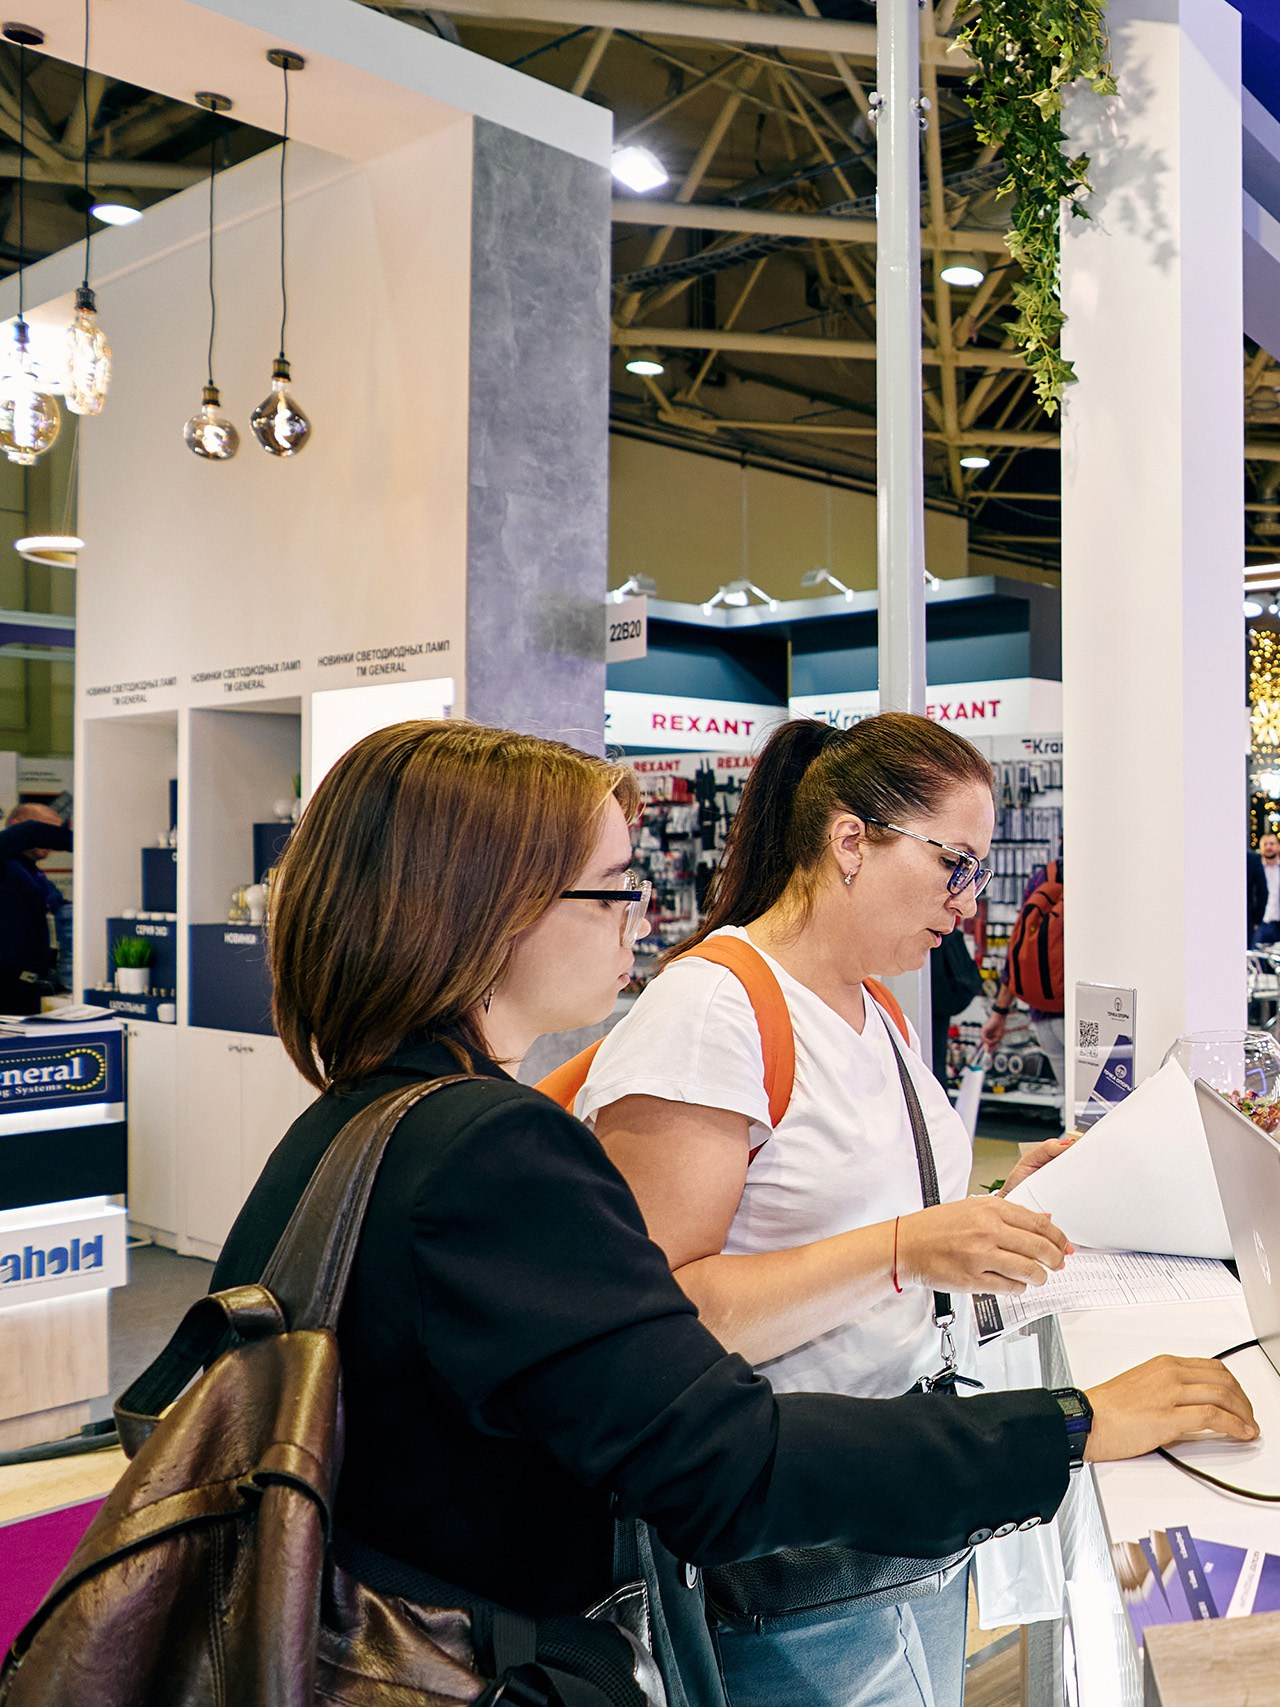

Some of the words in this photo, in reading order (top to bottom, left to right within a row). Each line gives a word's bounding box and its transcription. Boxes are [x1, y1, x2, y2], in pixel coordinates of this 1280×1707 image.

[609, 619, 642, 642] 22B20
[317, 653, 354, 668] НОВИНКИ
[355, 645, 424, 663] СВЕТОДИОДНЫХ
[425, 640, 450, 655] ЛАМП
[191, 671, 222, 684] НОВИНКИ
[223, 663, 280, 680] СВЕТОДИОДНЫХ
[368, 662, 406, 676] GENERAL
[233, 679, 265, 692] GENERAL
[926, 699, 1001, 721] EXANT
[652, 713, 755, 736] REXANT
[1033, 739, 1063, 754] Kra
[717, 756, 757, 769] REXA
[0, 1056, 82, 1086] neral
[15, 1084, 62, 1096] Systems
